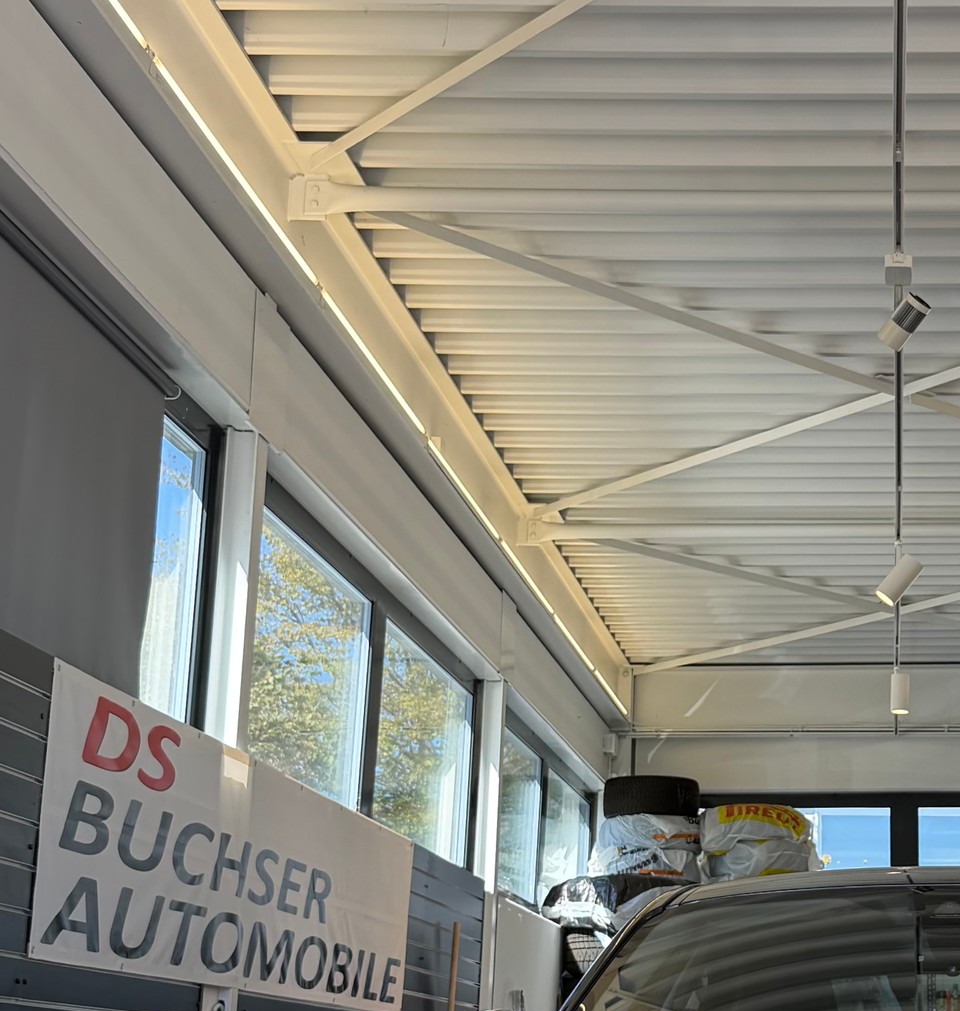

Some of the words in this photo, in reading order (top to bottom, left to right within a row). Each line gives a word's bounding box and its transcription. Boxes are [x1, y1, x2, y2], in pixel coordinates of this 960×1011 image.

[82, 695, 181, 792] DS
[58, 780, 332, 924] BUCHSER
[40, 876, 401, 1004] AUTOMOBILE
